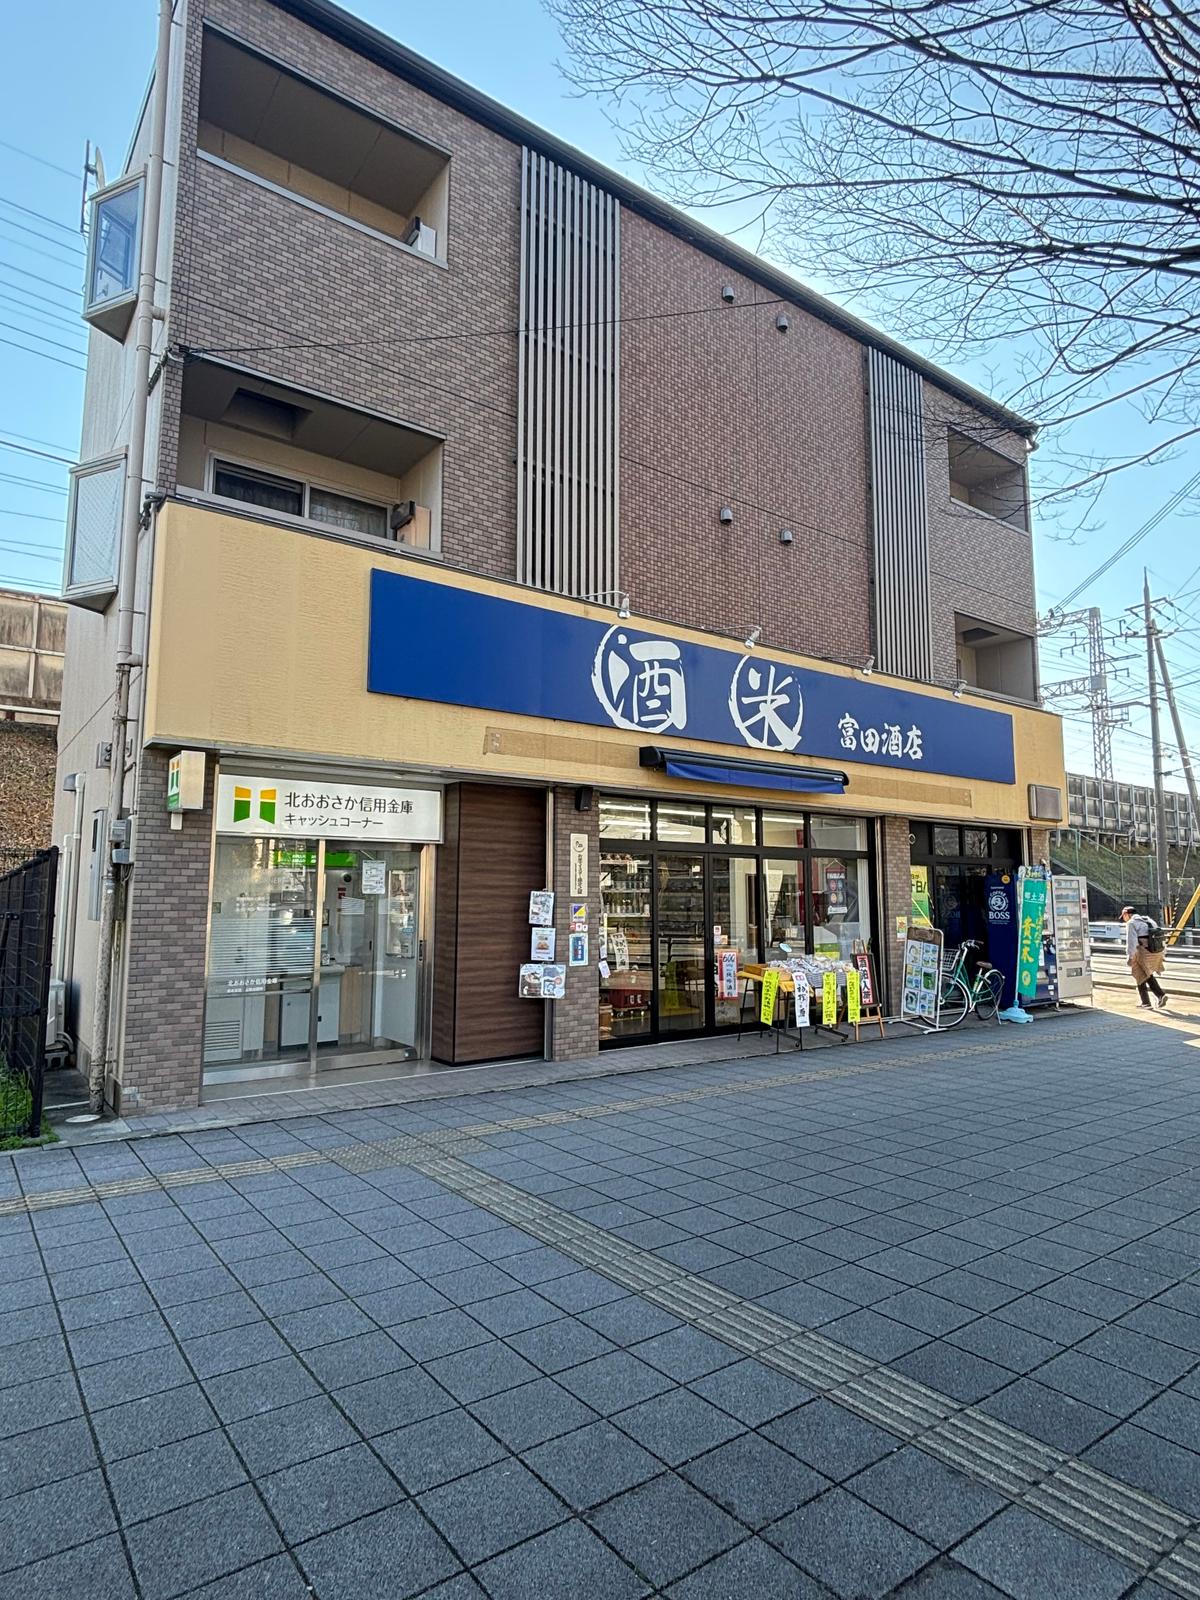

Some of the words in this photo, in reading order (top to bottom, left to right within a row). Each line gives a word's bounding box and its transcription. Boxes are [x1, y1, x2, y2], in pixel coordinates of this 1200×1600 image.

[599, 629, 688, 731] 酒
[735, 660, 802, 750] 米
[838, 713, 923, 760] 富田酒店
[284, 791, 414, 815] 北おおさか信用金庫
[284, 812, 384, 829] キャッシュコーナー
[988, 911, 1010, 920] BOSS
